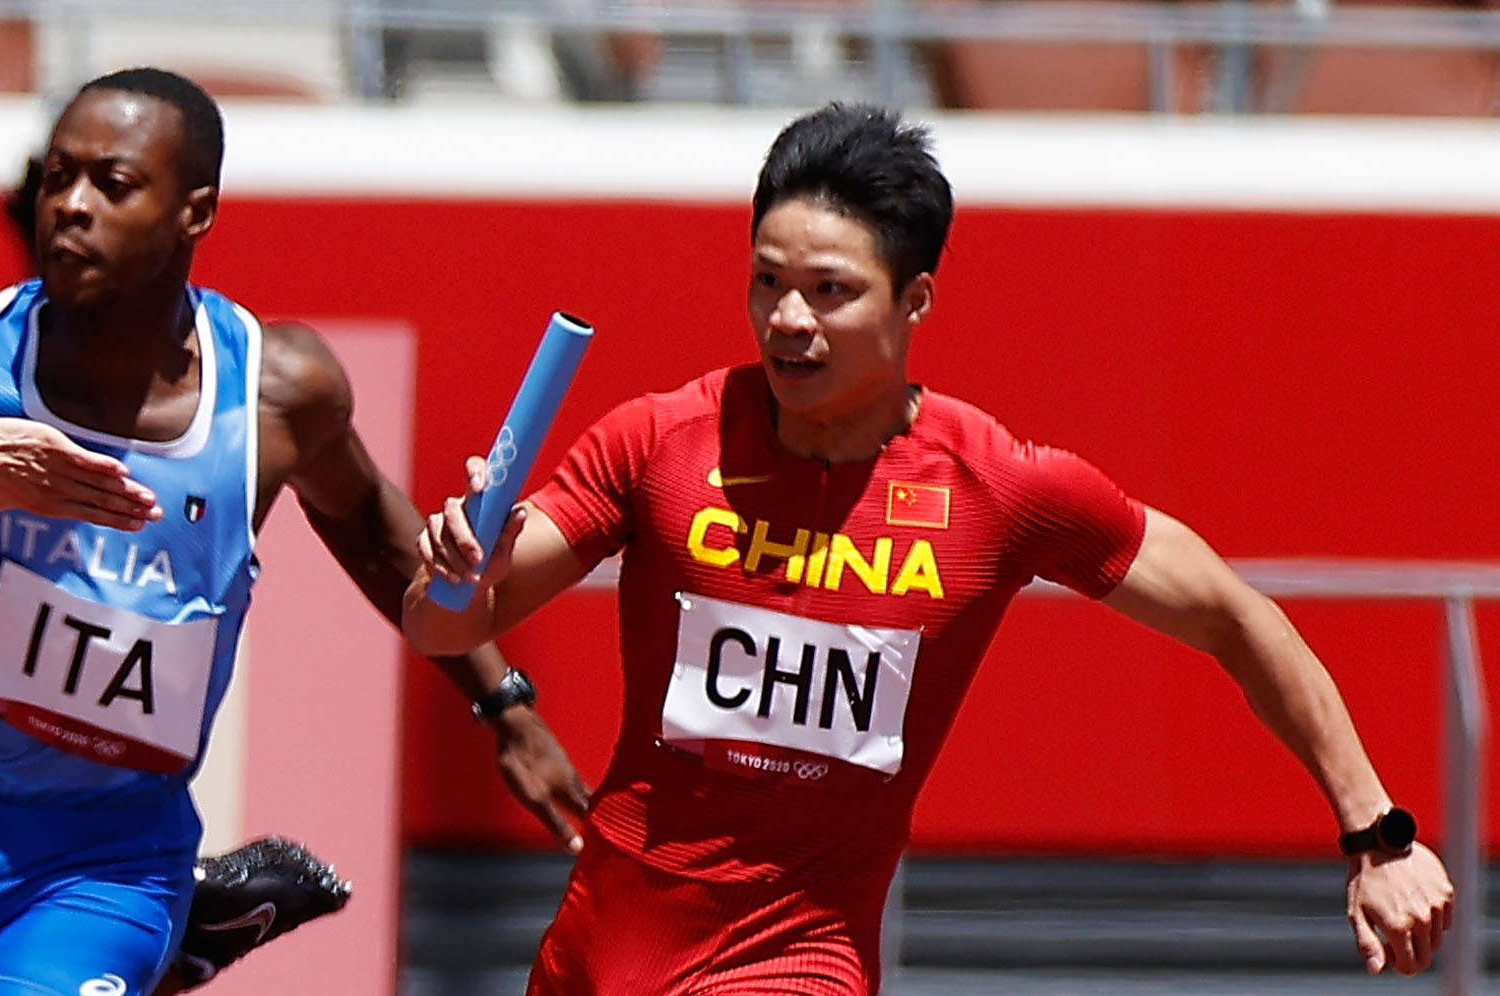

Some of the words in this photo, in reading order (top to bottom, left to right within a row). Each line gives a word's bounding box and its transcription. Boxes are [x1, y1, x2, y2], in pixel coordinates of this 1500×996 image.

[1, 513, 178, 595] ITALIA
[686, 506, 945, 599] CHINA
[22, 602, 155, 715] ITA
[705, 627, 882, 732] CHN
[726, 749, 762, 769] TOKYO
[762, 757, 791, 774] 2020
